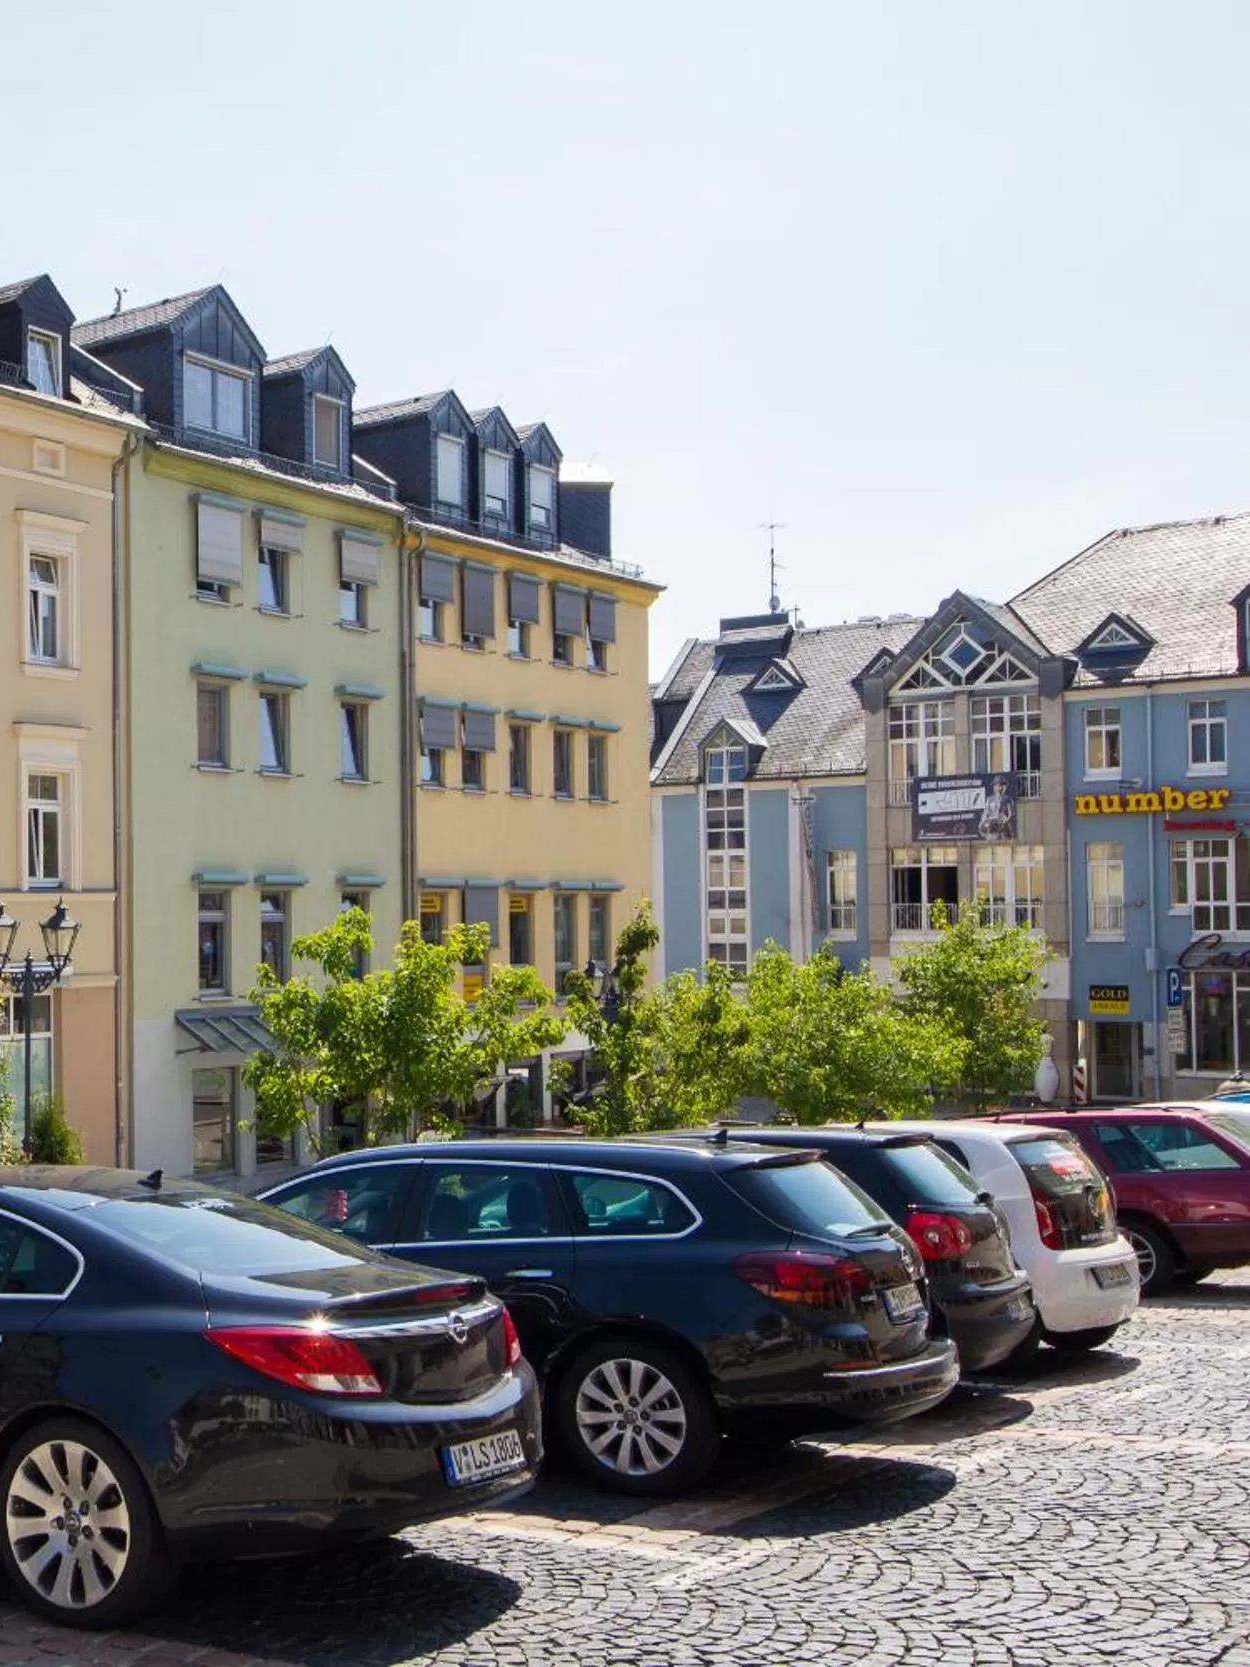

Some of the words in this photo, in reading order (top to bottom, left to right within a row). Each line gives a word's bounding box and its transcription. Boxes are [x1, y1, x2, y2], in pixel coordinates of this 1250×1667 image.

[1075, 786, 1230, 815] number
[1091, 988, 1126, 998] GOLD
[1170, 972, 1179, 1003] P
[452, 1447, 464, 1475] V
[470, 1441, 492, 1469] LS
[491, 1433, 522, 1464] 1806
